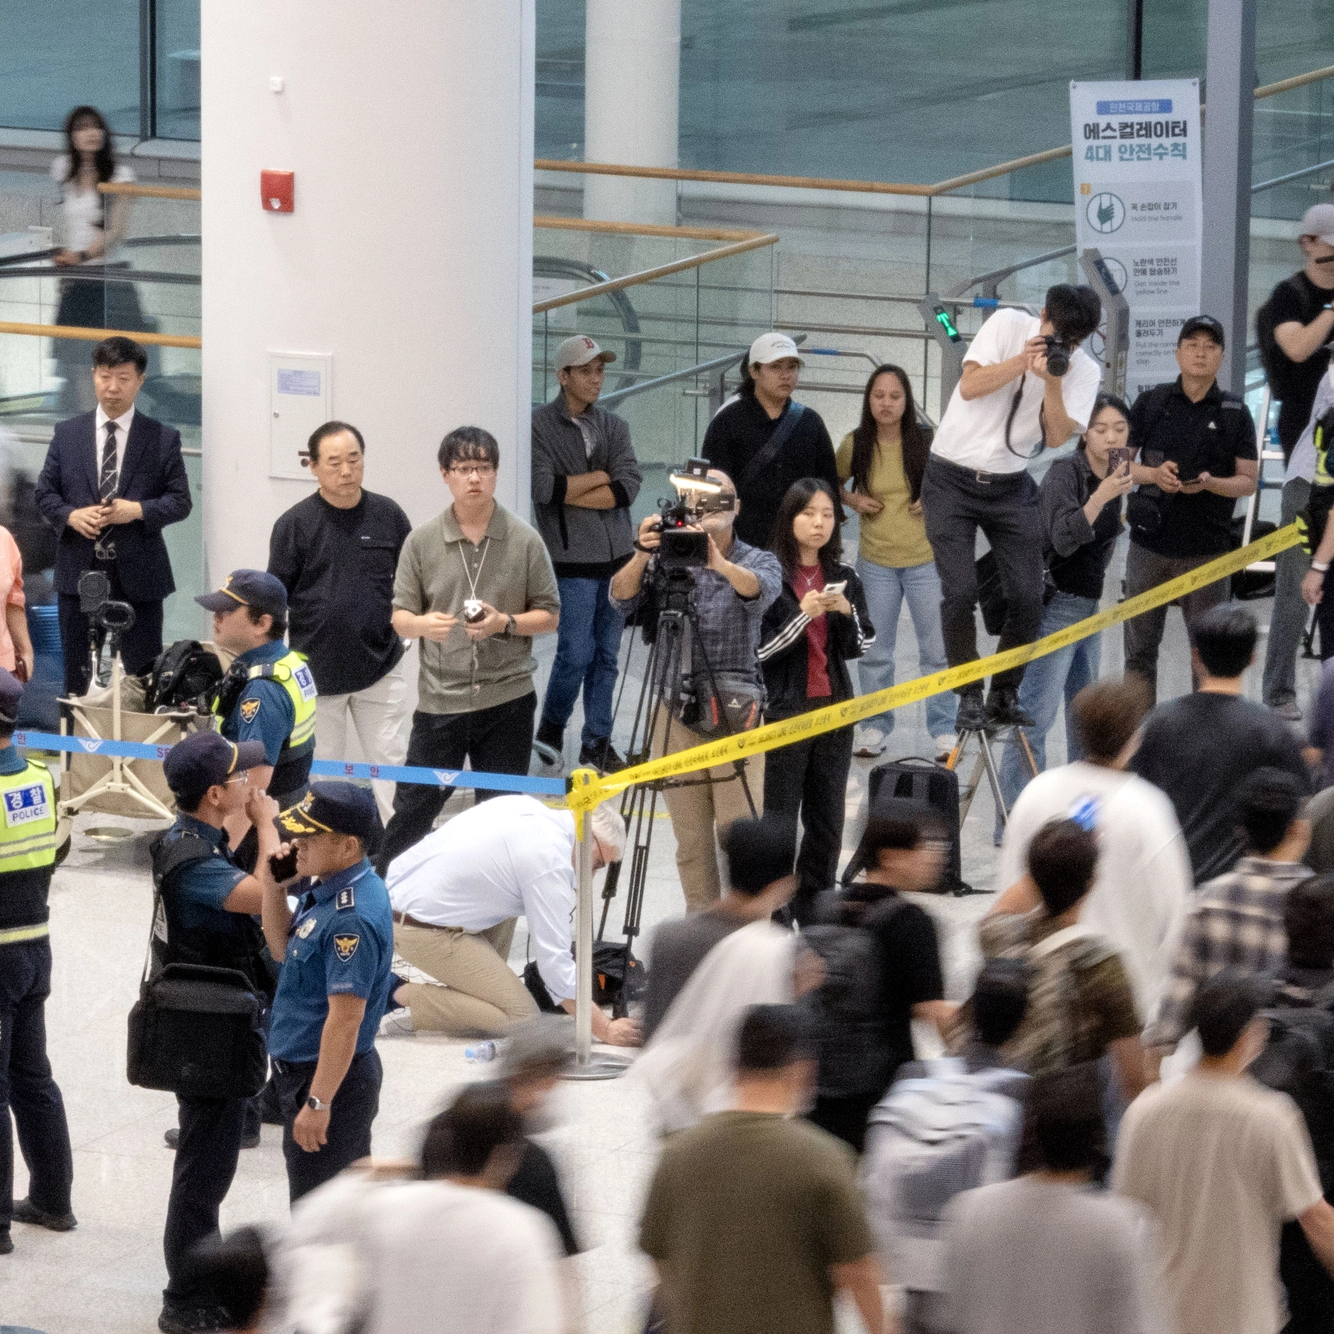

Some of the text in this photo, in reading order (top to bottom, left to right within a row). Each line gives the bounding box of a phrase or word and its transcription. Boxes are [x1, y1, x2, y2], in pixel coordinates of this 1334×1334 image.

[1083, 120, 1188, 140] 에스컬레이터
[1084, 142, 1187, 162] 4대 안전수칙
[582, 337, 595, 349] B
[7, 786, 43, 809] 경찰
[12, 807, 45, 822] POLICE
